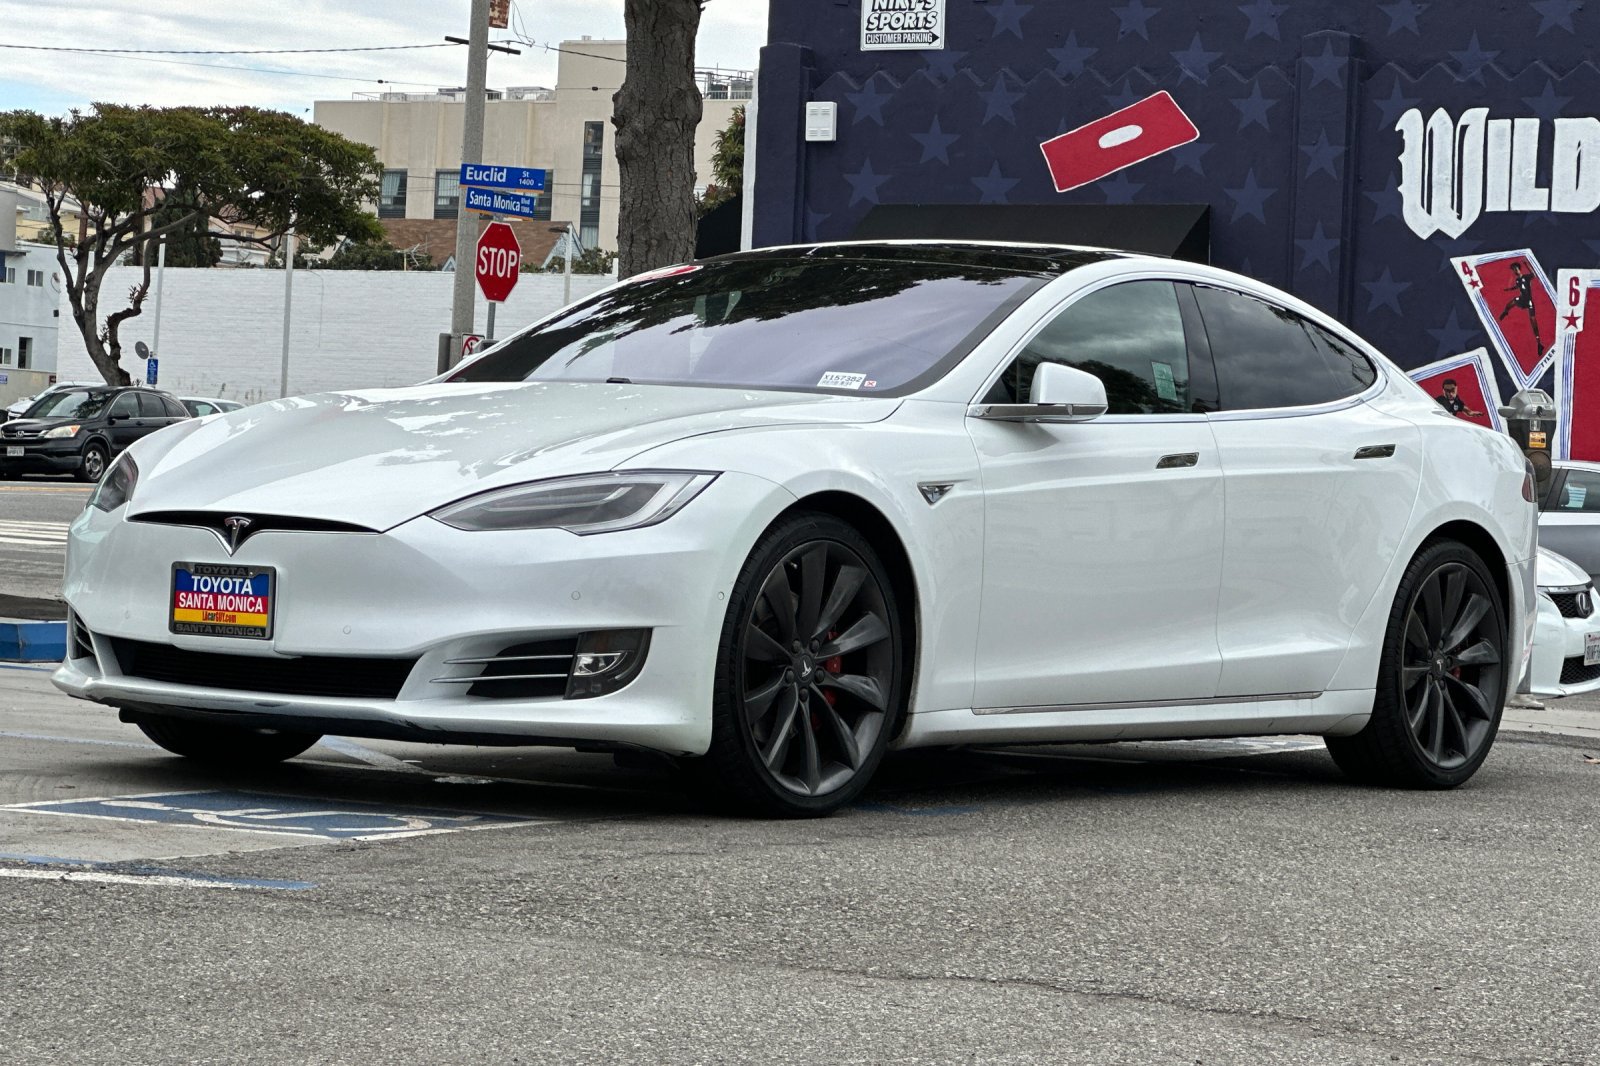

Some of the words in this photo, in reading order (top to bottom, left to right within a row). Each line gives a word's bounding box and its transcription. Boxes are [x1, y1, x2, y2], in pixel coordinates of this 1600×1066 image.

[866, 11, 939, 31] SPORTS
[866, 33, 902, 44] CUSTOMER
[902, 32, 933, 43] PARKING
[465, 167, 507, 182] Euclid
[522, 170, 530, 178] St
[519, 178, 534, 186] 1400
[469, 191, 491, 207] Santa
[493, 195, 521, 212] Monica
[478, 246, 517, 278] STOP
[1461, 260, 1474, 277] 4
[1569, 275, 1580, 306] 6
[196, 566, 247, 576] TOYOTA
[191, 575, 253, 595] TOYOTA
[178, 592, 214, 610] SANTA
[217, 595, 264, 613] MONICA
[175, 622, 213, 633] SANTA
[215, 626, 263, 637] MONICA
